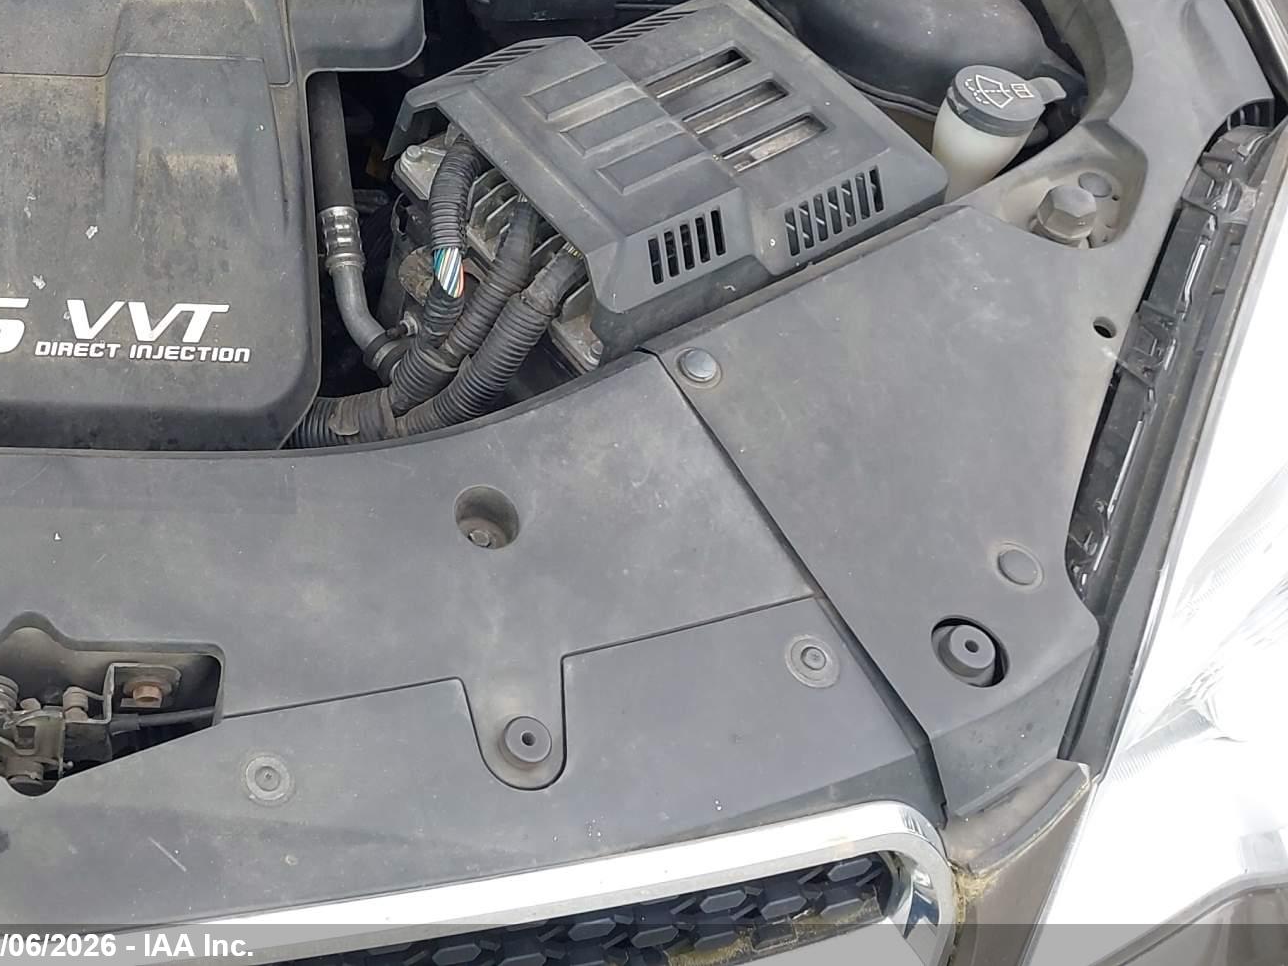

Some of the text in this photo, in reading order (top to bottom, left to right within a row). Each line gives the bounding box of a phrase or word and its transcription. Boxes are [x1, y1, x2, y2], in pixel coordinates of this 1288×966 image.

[65, 299, 230, 343] VVT
[34, 340, 251, 363] DIRECT INJECTION
